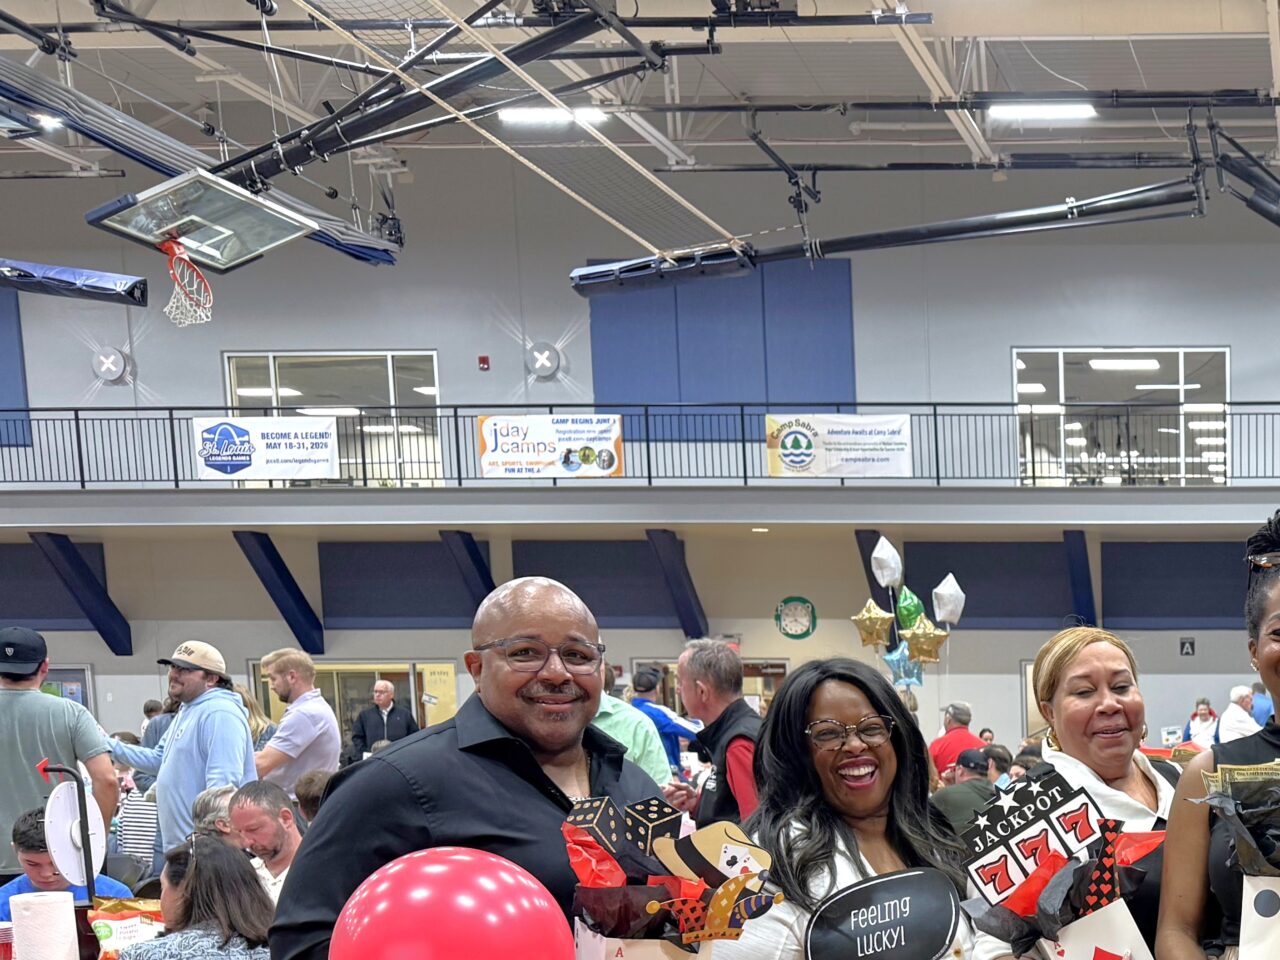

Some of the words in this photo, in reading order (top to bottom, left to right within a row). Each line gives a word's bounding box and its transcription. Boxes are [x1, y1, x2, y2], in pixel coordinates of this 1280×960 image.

[261, 432, 292, 440] BECOME
[300, 431, 332, 439] LEGEND!
[499, 424, 529, 441] day
[770, 420, 794, 440] Camp
[794, 419, 819, 438] Sabra
[220, 440, 256, 456] Louis
[265, 442, 281, 450] MAY
[500, 441, 557, 456] camps
[1182, 642, 1193, 654] A
[974, 785, 1064, 853] JACKPOT
[975, 854, 1015, 895] 7
[1017, 828, 1051, 869] 7
[1058, 803, 1097, 843] 7
[857, 925, 906, 957] LUCKY!
[615, 947, 624, 958] A
